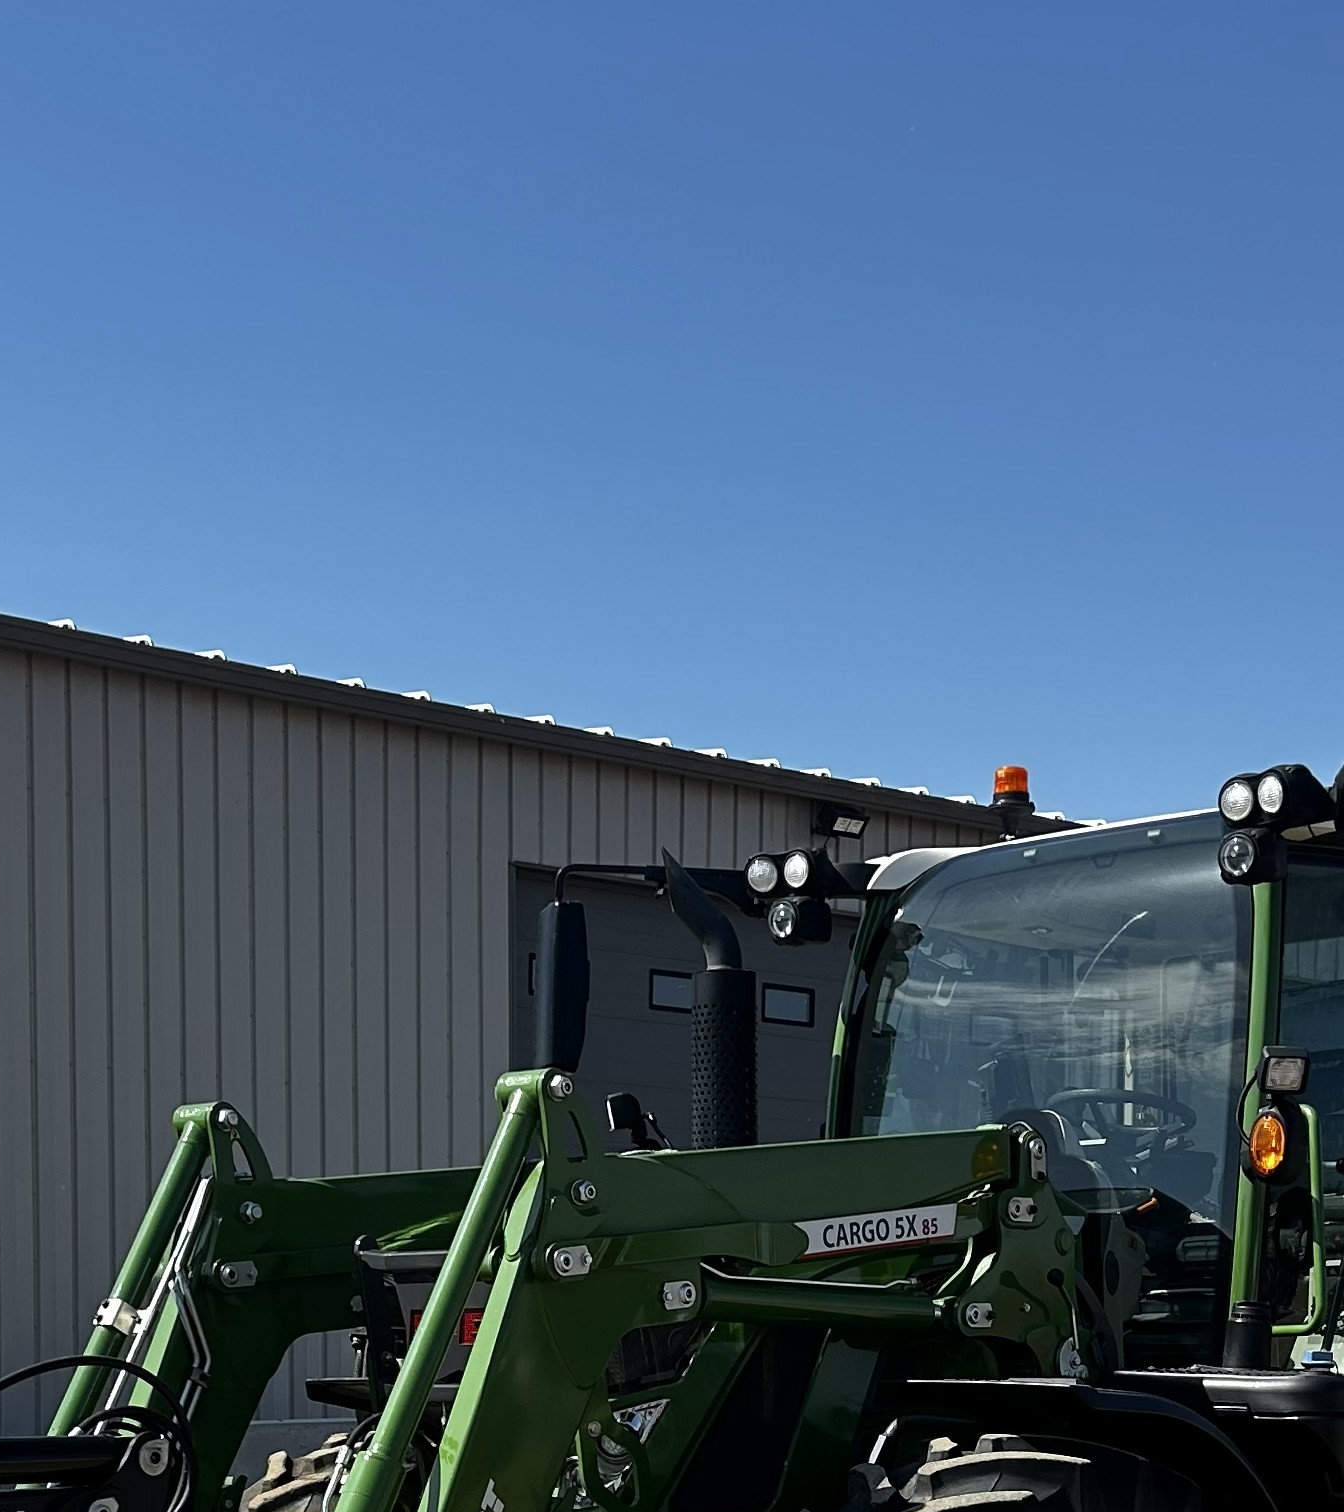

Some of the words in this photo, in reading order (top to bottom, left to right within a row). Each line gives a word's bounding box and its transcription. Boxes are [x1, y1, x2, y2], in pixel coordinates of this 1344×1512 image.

[822, 1218, 890, 1248] CARGO
[895, 1215, 918, 1239] 5X
[922, 1218, 938, 1235] 85
